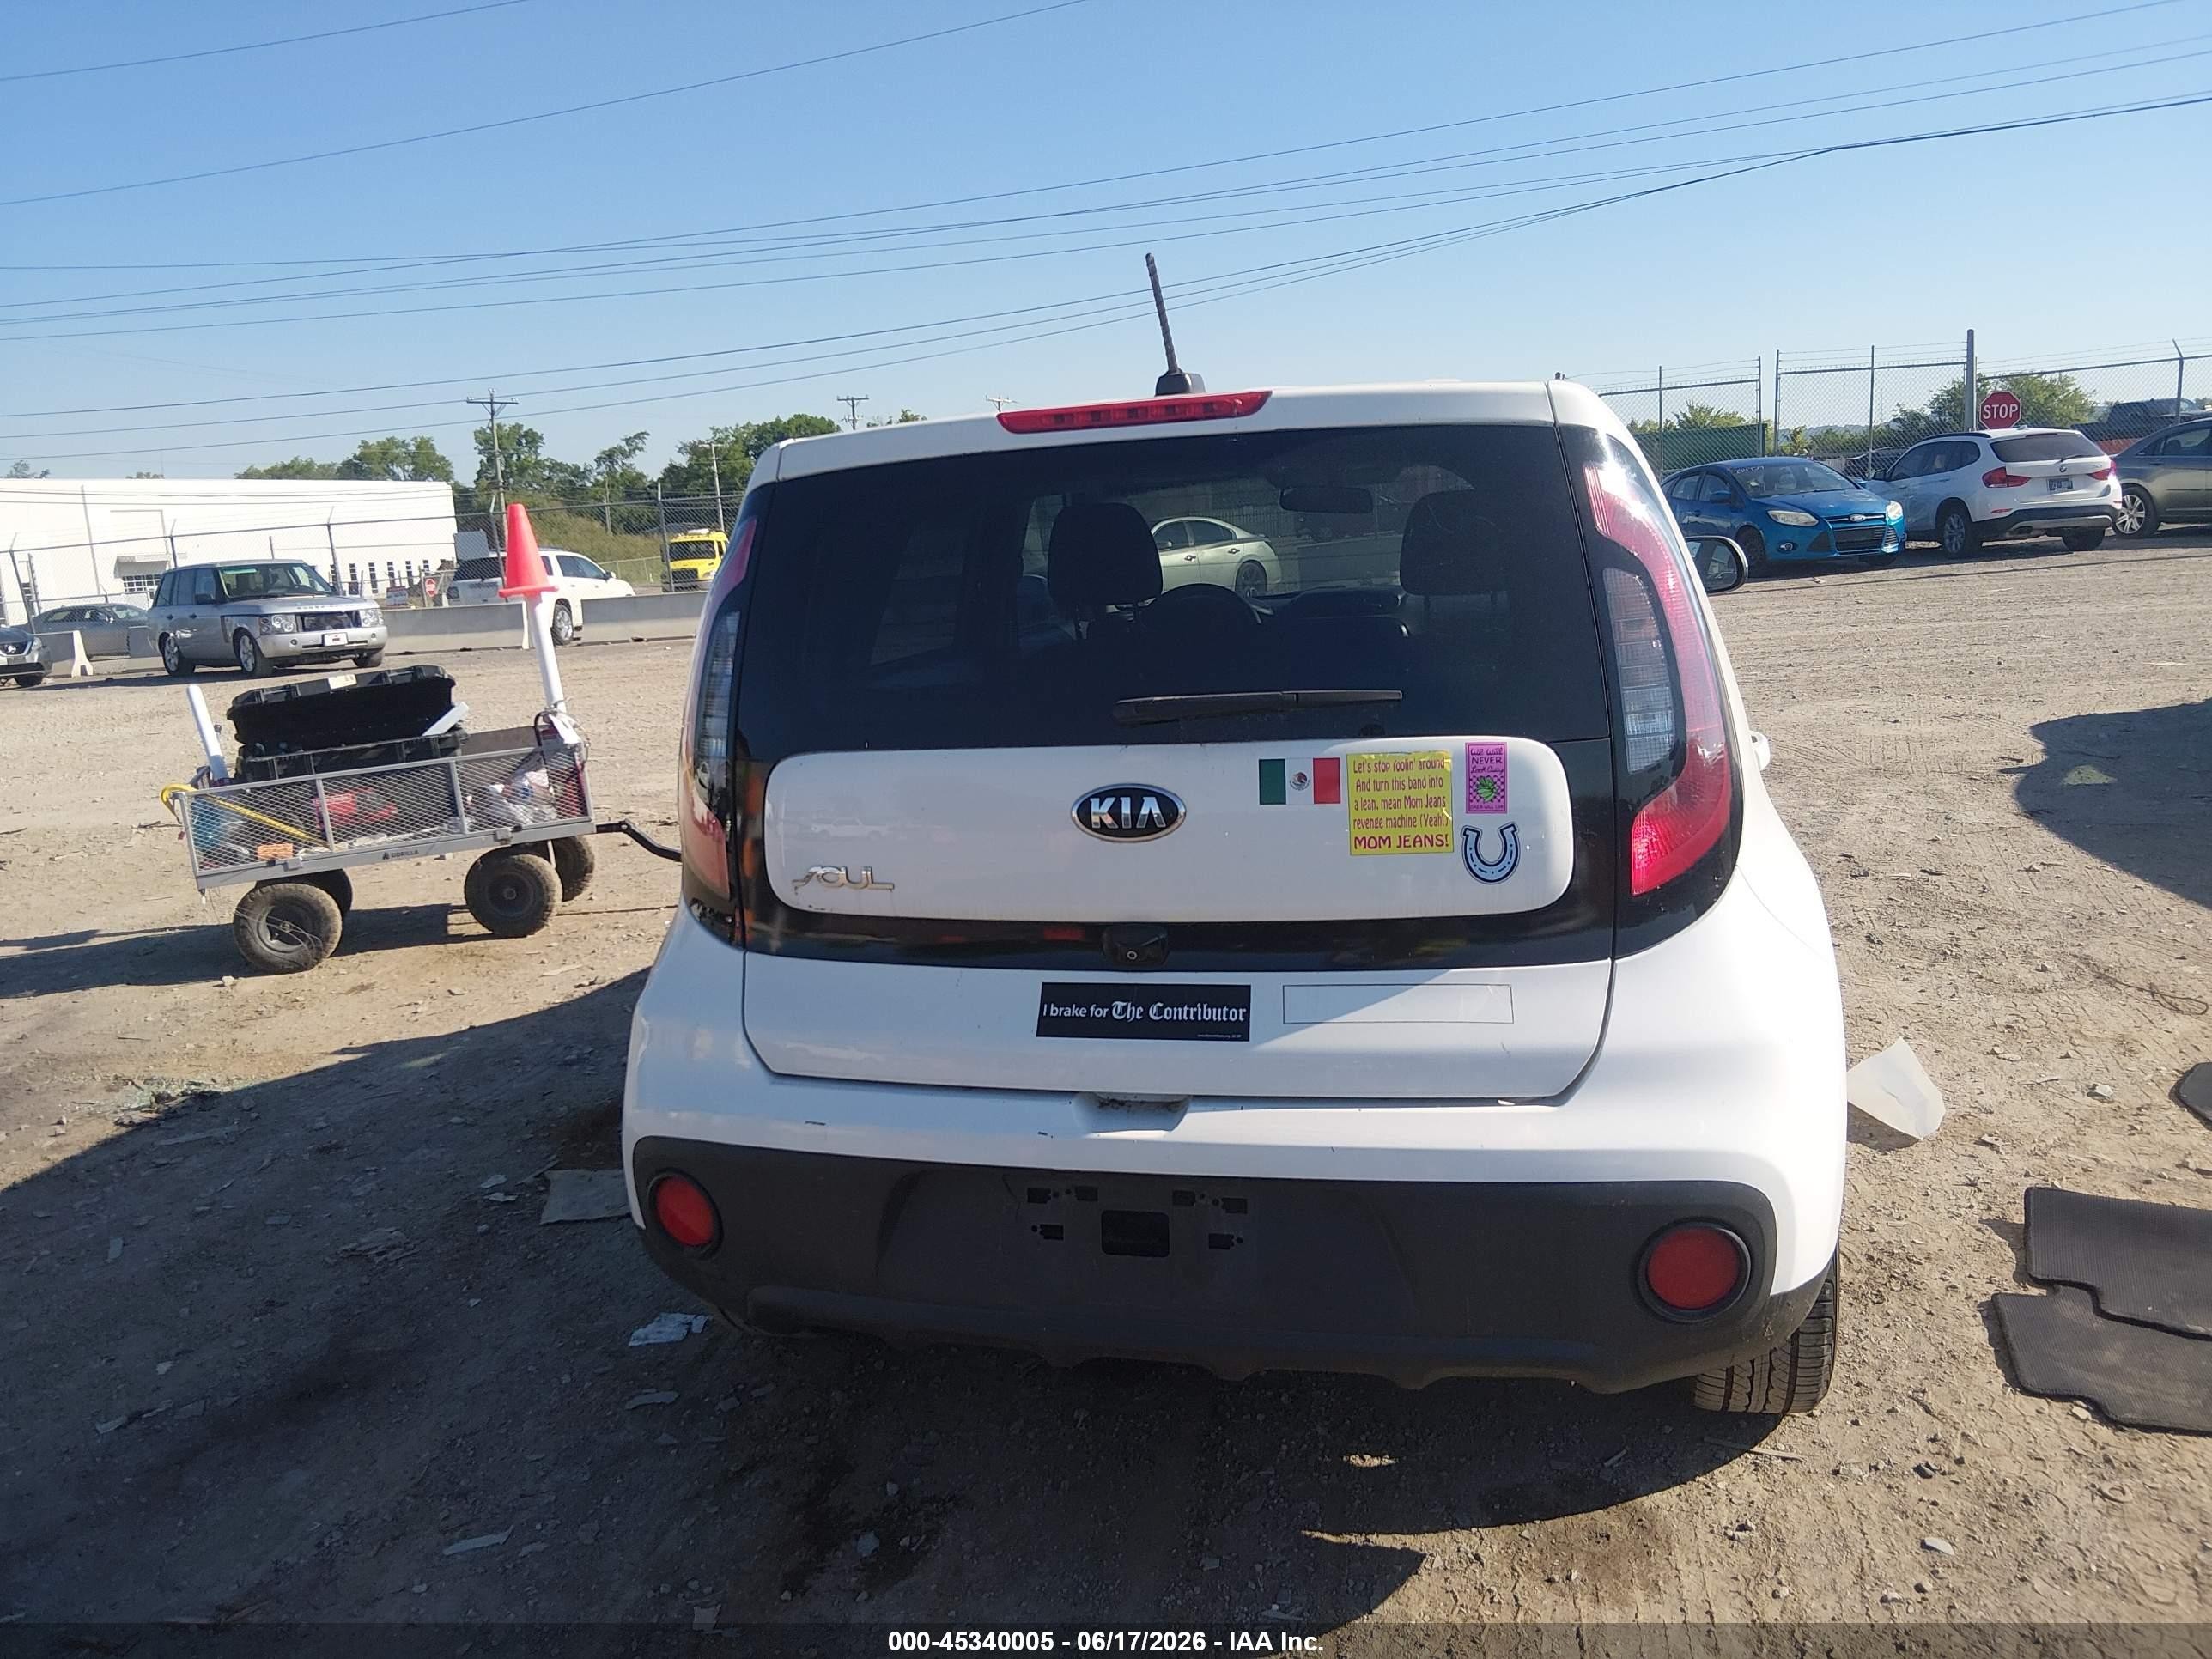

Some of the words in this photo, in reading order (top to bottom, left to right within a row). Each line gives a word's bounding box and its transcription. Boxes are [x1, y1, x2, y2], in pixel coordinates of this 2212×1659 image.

[1983, 404, 2018, 419] STOP
[1353, 760, 1371, 773] Let's
[1374, 761, 1390, 773] stop
[1418, 757, 1444, 770] around
[1356, 778, 1370, 792] And
[1373, 779, 1389, 791] turn
[1391, 776, 1406, 790] this
[1408, 776, 1425, 790] band
[1428, 775, 1443, 788] into
[1354, 799, 1358, 811] a
[1381, 799, 1401, 810] mean
[1404, 795, 1423, 809] Mom
[1425, 793, 1446, 808] Jeans
[1090, 796, 1166, 829] KIA
[1353, 817, 1383, 830] revenge
[1385, 813, 1417, 829] machine
[1419, 812, 1449, 828] (Yeah!)
[1354, 835, 1391, 849] MOM
[1396, 834, 1449, 848] JEANS!
[1043, 1003, 1048, 1017] I
[1050, 1003, 1087, 1018] brake
[1090, 1004, 1109, 1018] for
[1111, 1000, 1144, 1023] The
[1149, 1002, 1247, 1022] Contributor
